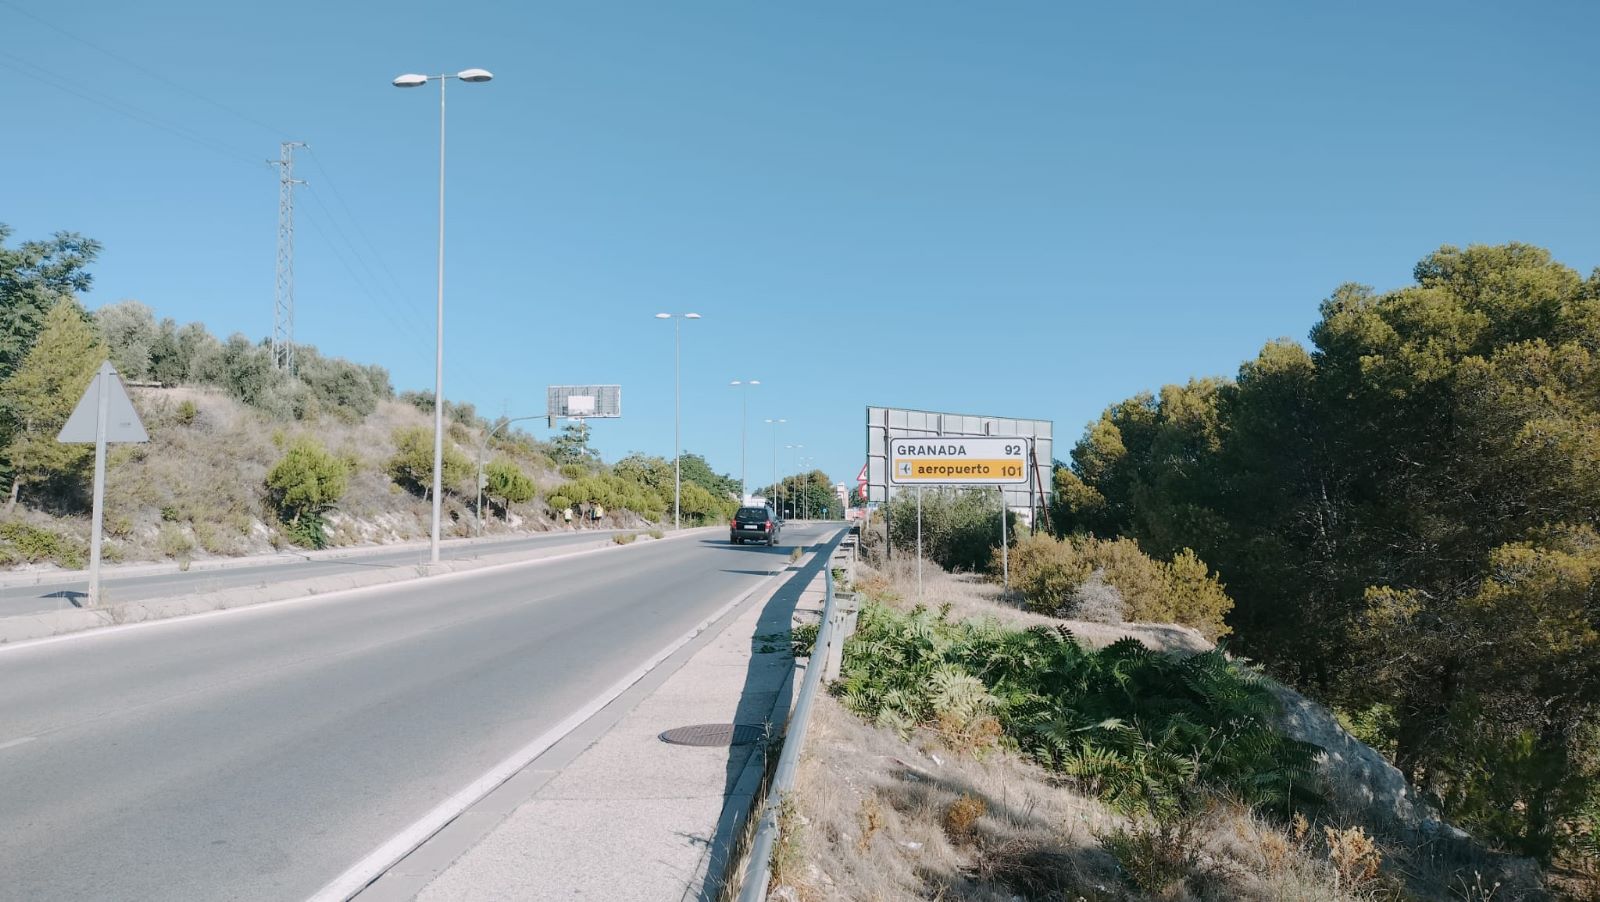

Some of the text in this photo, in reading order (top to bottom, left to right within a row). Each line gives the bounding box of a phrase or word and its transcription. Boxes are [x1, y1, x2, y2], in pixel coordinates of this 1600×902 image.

[897, 445, 1021, 456] GRANADA 92
[918, 463, 1022, 477] aeropuerto 101
